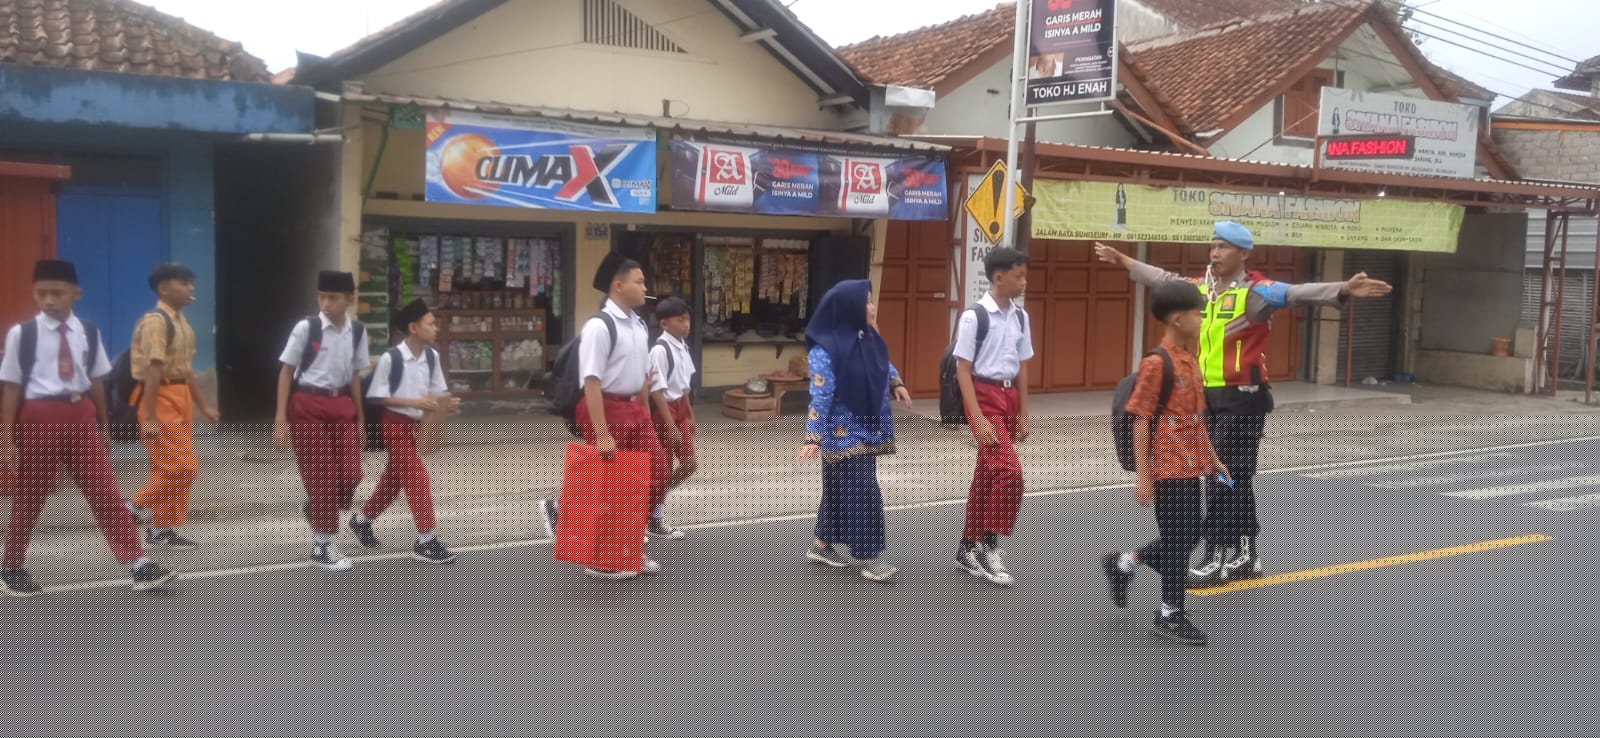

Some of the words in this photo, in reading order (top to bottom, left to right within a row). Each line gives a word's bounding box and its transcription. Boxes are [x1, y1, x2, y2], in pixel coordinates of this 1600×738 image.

[1045, 14, 1072, 26] GARIS
[1071, 8, 1103, 21] MERAH
[1044, 28, 1071, 39] ISINYA
[1071, 26, 1080, 35] A
[1080, 22, 1102, 34] MILD
[1033, 85, 1061, 99] TOKO
[1063, 83, 1076, 96] HJ
[1078, 80, 1107, 94] ENAH
[1394, 101, 1417, 114] TOKO
[1350, 139, 1408, 155] FASHION
[714, 151, 743, 181] A
[475, 144, 634, 207] CLIMAX
[853, 164, 880, 191] A
[714, 185, 740, 196] Mild
[771, 181, 791, 189] GARIS
[771, 190, 791, 198] ISINYA
[797, 191, 813, 199] MILD
[853, 194, 876, 204] Mild
[1172, 189, 1206, 203] TOKO
[1036, 227, 1058, 236] JALAN
[1058, 229, 1074, 237] RAYA
